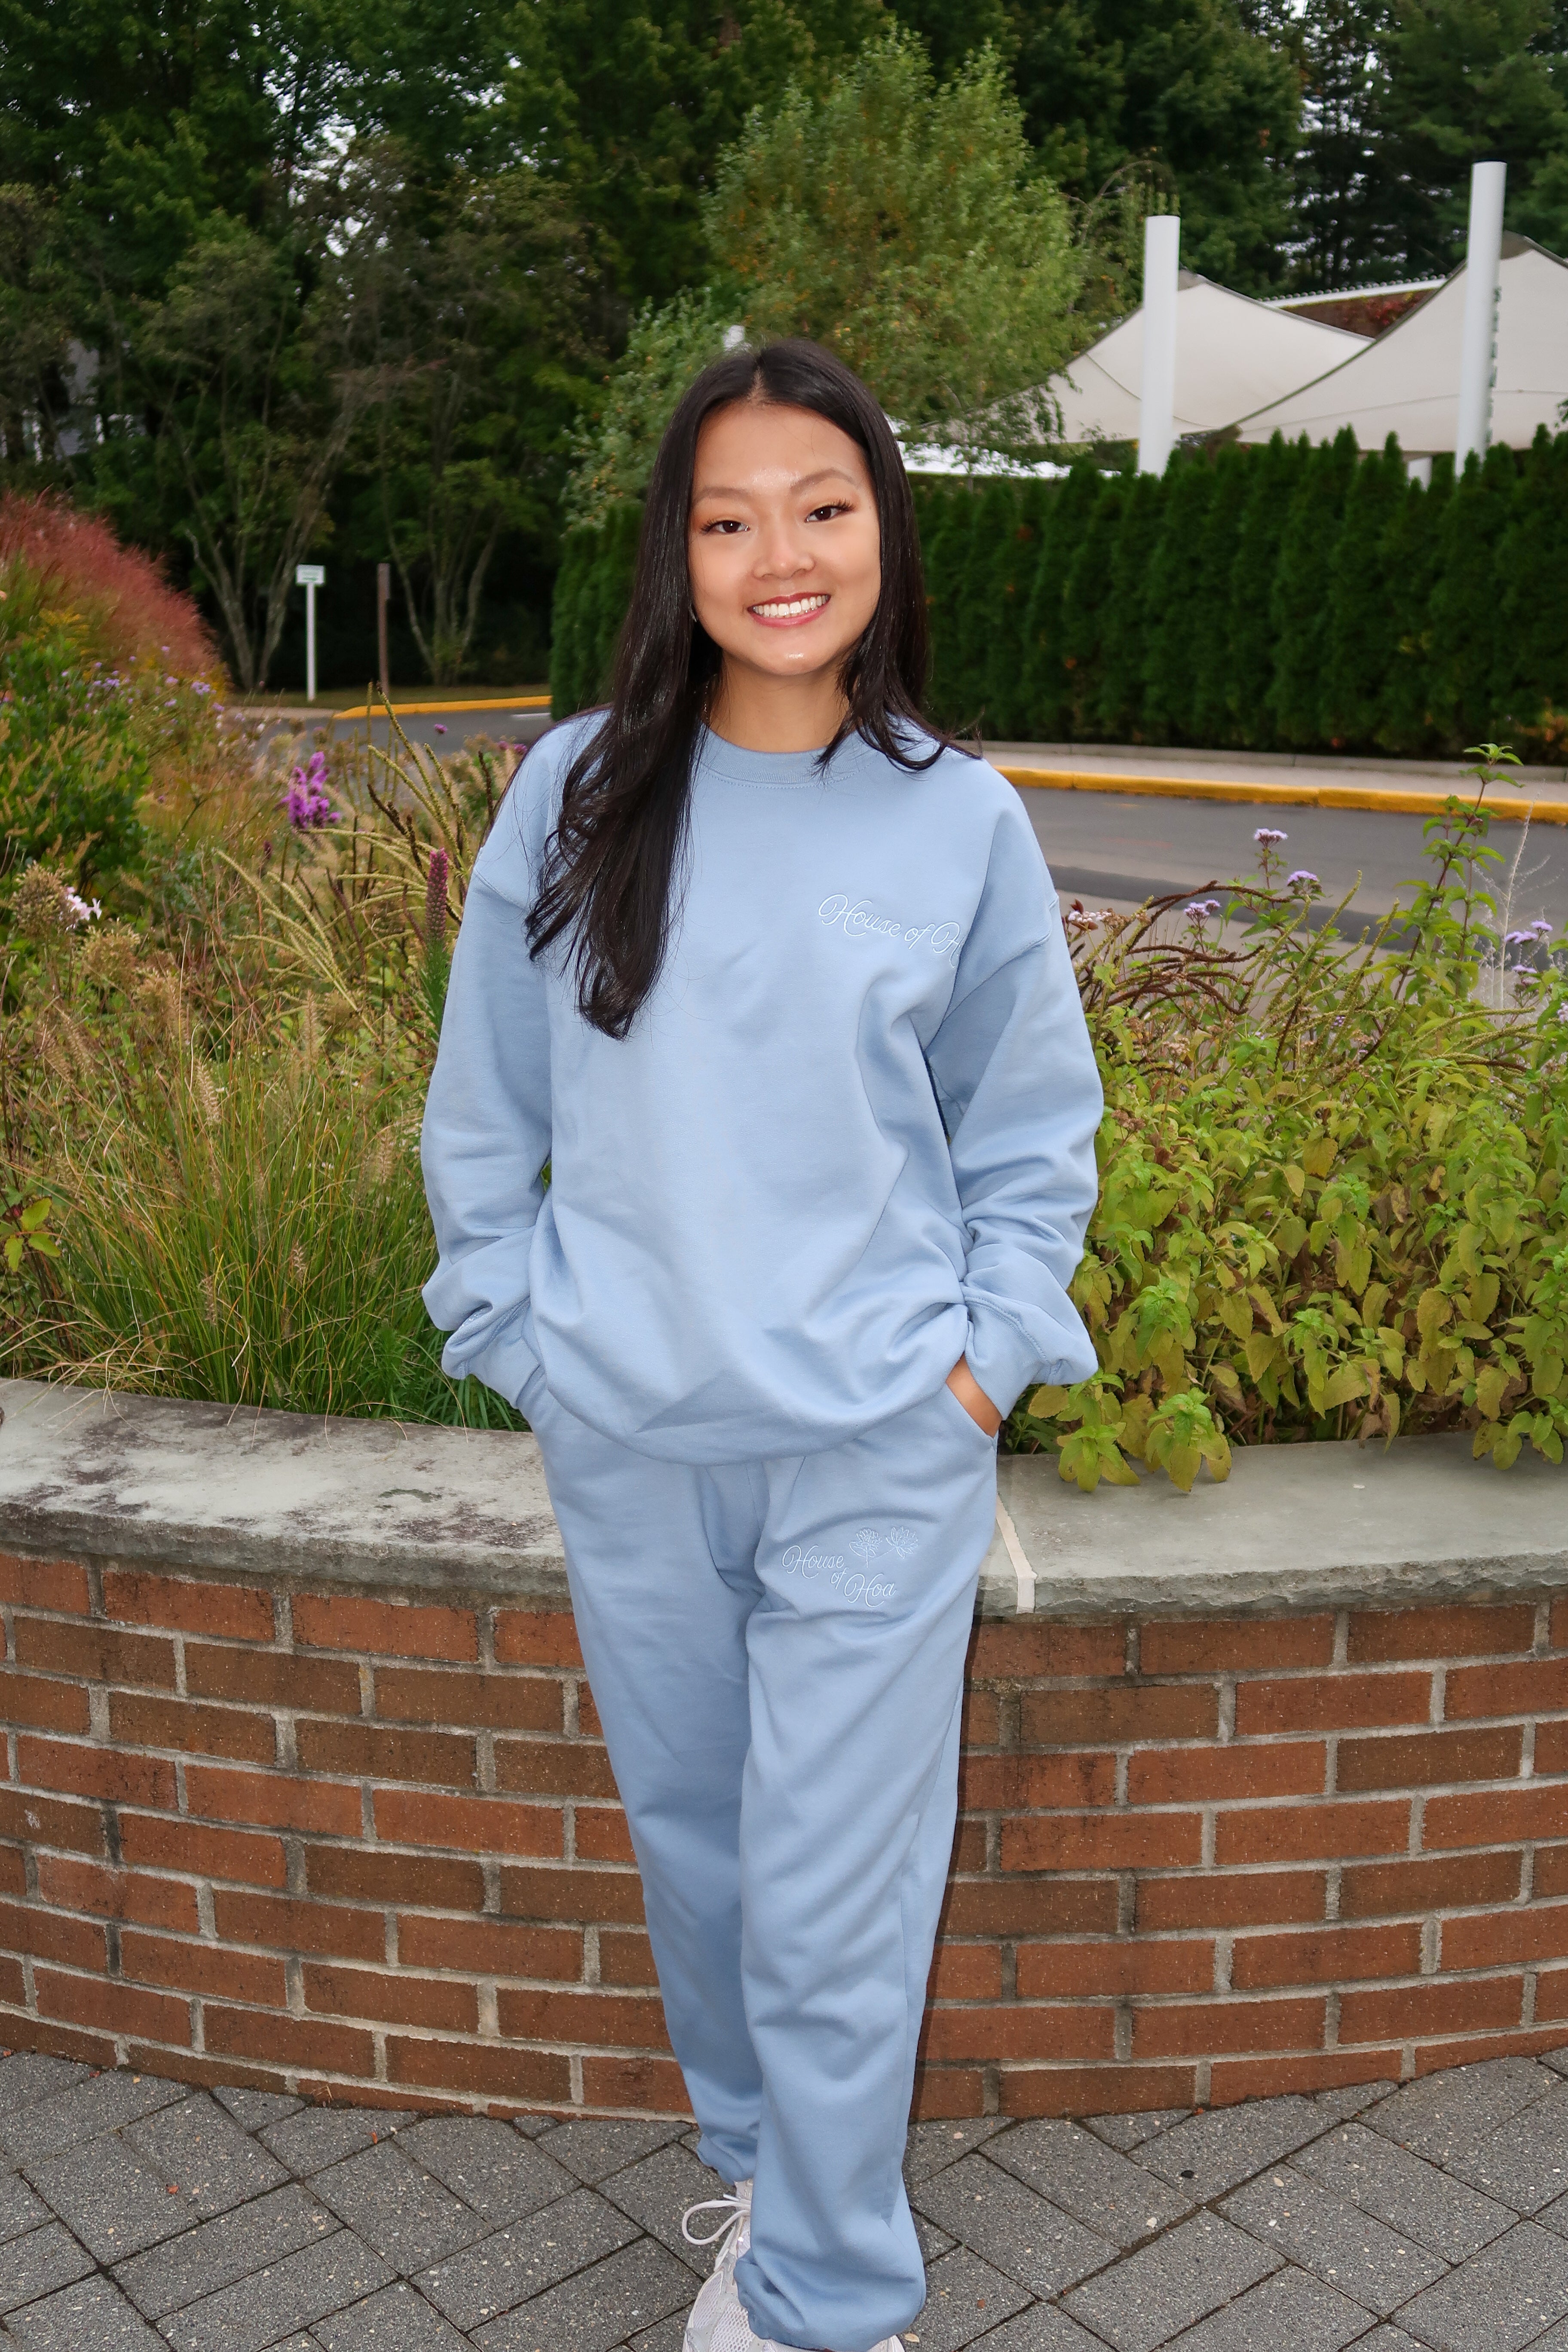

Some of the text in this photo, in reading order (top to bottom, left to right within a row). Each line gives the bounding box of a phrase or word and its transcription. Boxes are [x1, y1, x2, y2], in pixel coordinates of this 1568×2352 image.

[818, 894, 902, 937] House
[904, 923, 935, 950] of
[782, 1545, 845, 1579] House
[830, 1567, 849, 1590] of
[844, 1573, 897, 1608] Hoa
